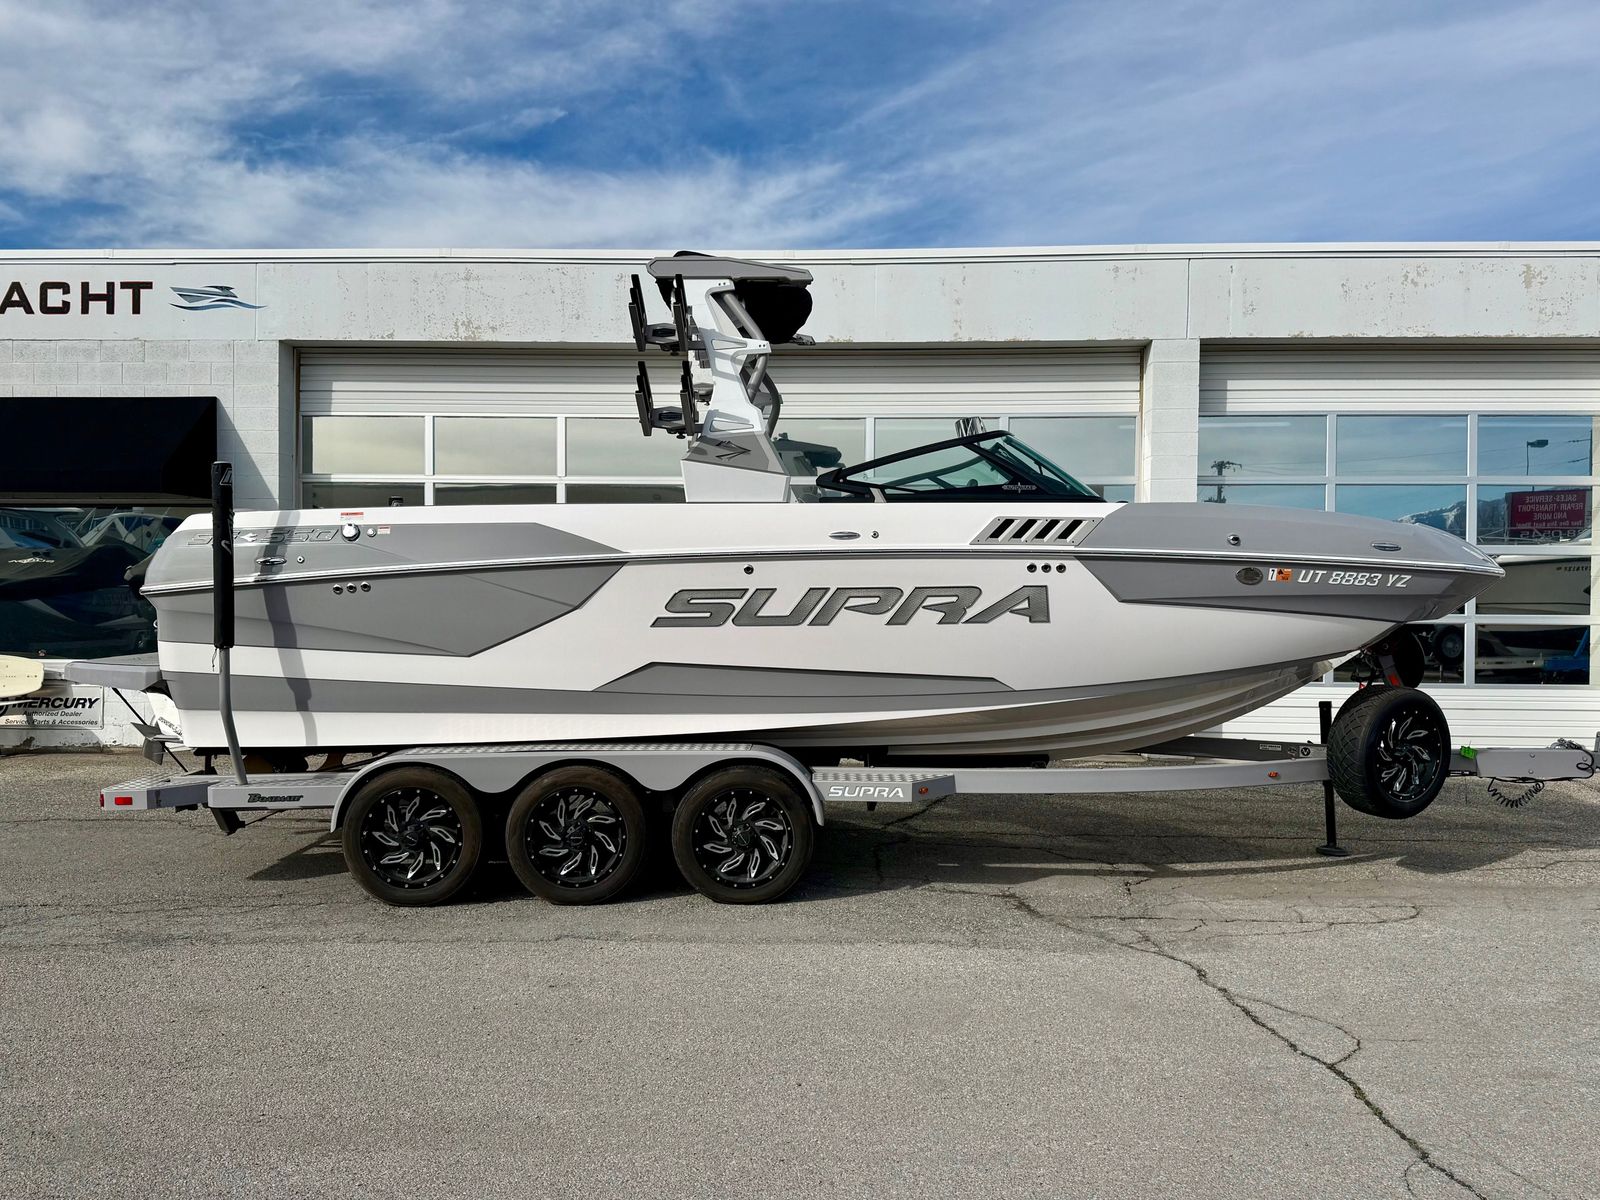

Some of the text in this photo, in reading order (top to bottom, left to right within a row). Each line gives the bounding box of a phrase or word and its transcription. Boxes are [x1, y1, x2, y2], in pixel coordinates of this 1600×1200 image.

[0, 281, 153, 315] ACHT
[1297, 570, 1326, 584] UT
[1328, 571, 1383, 587] 8883
[1386, 574, 1412, 588] YZ
[650, 584, 1051, 628] SUPRA
[59, 718, 98, 726] Accessories
[828, 785, 904, 798] SUPRA
